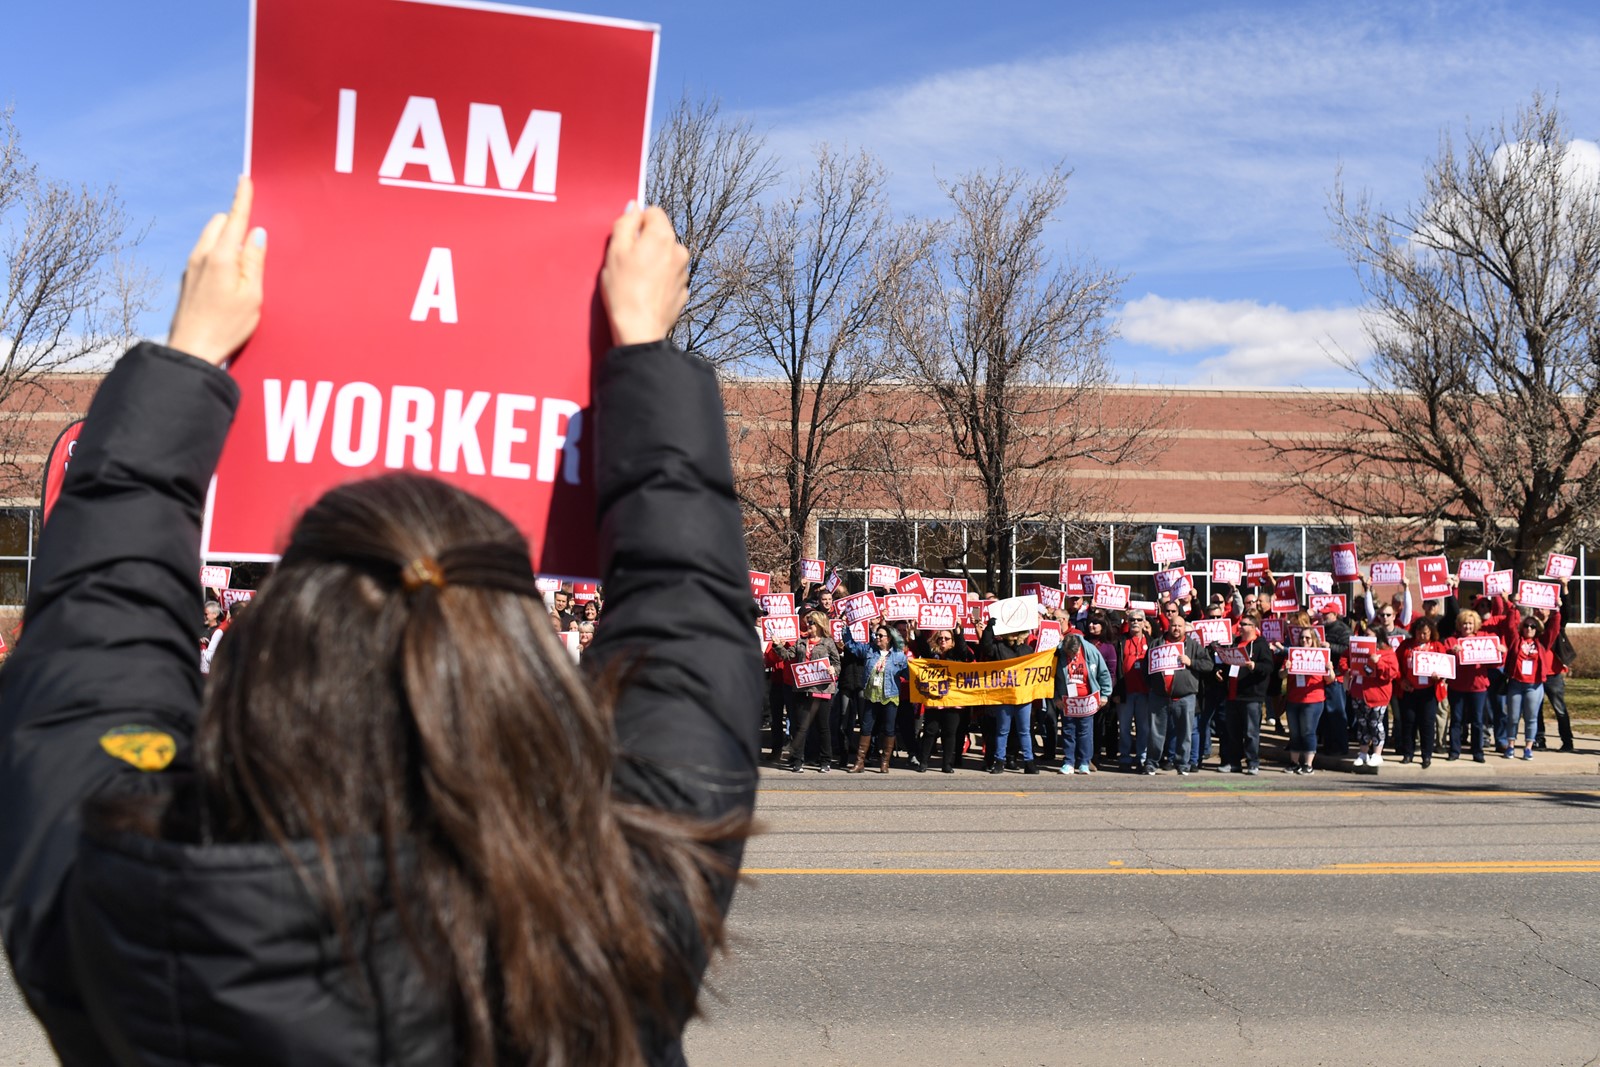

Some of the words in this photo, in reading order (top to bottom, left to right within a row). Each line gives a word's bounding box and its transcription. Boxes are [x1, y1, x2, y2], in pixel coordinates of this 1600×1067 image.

[335, 88, 357, 173] I
[378, 95, 562, 195] AM
[410, 247, 458, 324] A
[263, 378, 583, 484] WORKER
[1215, 561, 1240, 572] CWA
[1372, 563, 1400, 573] CWA
[1428, 563, 1442, 572] AM
[1461, 561, 1489, 571] CWA
[201, 568, 226, 577] CWA
[872, 567, 897, 577] CWA
[1157, 570, 1180, 581] CWA
[754, 578, 766, 586] AM
[1083, 573, 1110, 584] CWA
[1432, 574, 1437, 582] A
[1486, 572, 1510, 585] CWA
[905, 580, 918, 591] AM
[935, 580, 963, 590] CWA
[1521, 583, 1556, 596] CWA
[223, 591, 251, 601] CWA
[1098, 586, 1126, 597] CWA
[762, 596, 790, 606] CWA
[846, 595, 872, 612] CWA
[887, 596, 918, 607] CWA
[934, 593, 963, 604] CWA
[846, 604, 876, 621] STRONG
[920, 605, 953, 617] CWA
[764, 618, 795, 629] CWA
[833, 621, 865, 632] CA
[920, 616, 954, 626] STRONG
[1262, 621, 1280, 631] CWA
[1196, 621, 1227, 633] CWA
[1462, 639, 1497, 650] CWA
[1151, 645, 1180, 660] CWA
[1292, 650, 1325, 661] CWA
[796, 661, 827, 675] CWA
[1292, 660, 1326, 670] STRONG
[920, 669, 945, 680] CWA
[956, 672, 980, 688] CWA
[984, 669, 1020, 688] LOCAL
[1024, 665, 1052, 686] 7750
[1066, 695, 1098, 707] CWA
